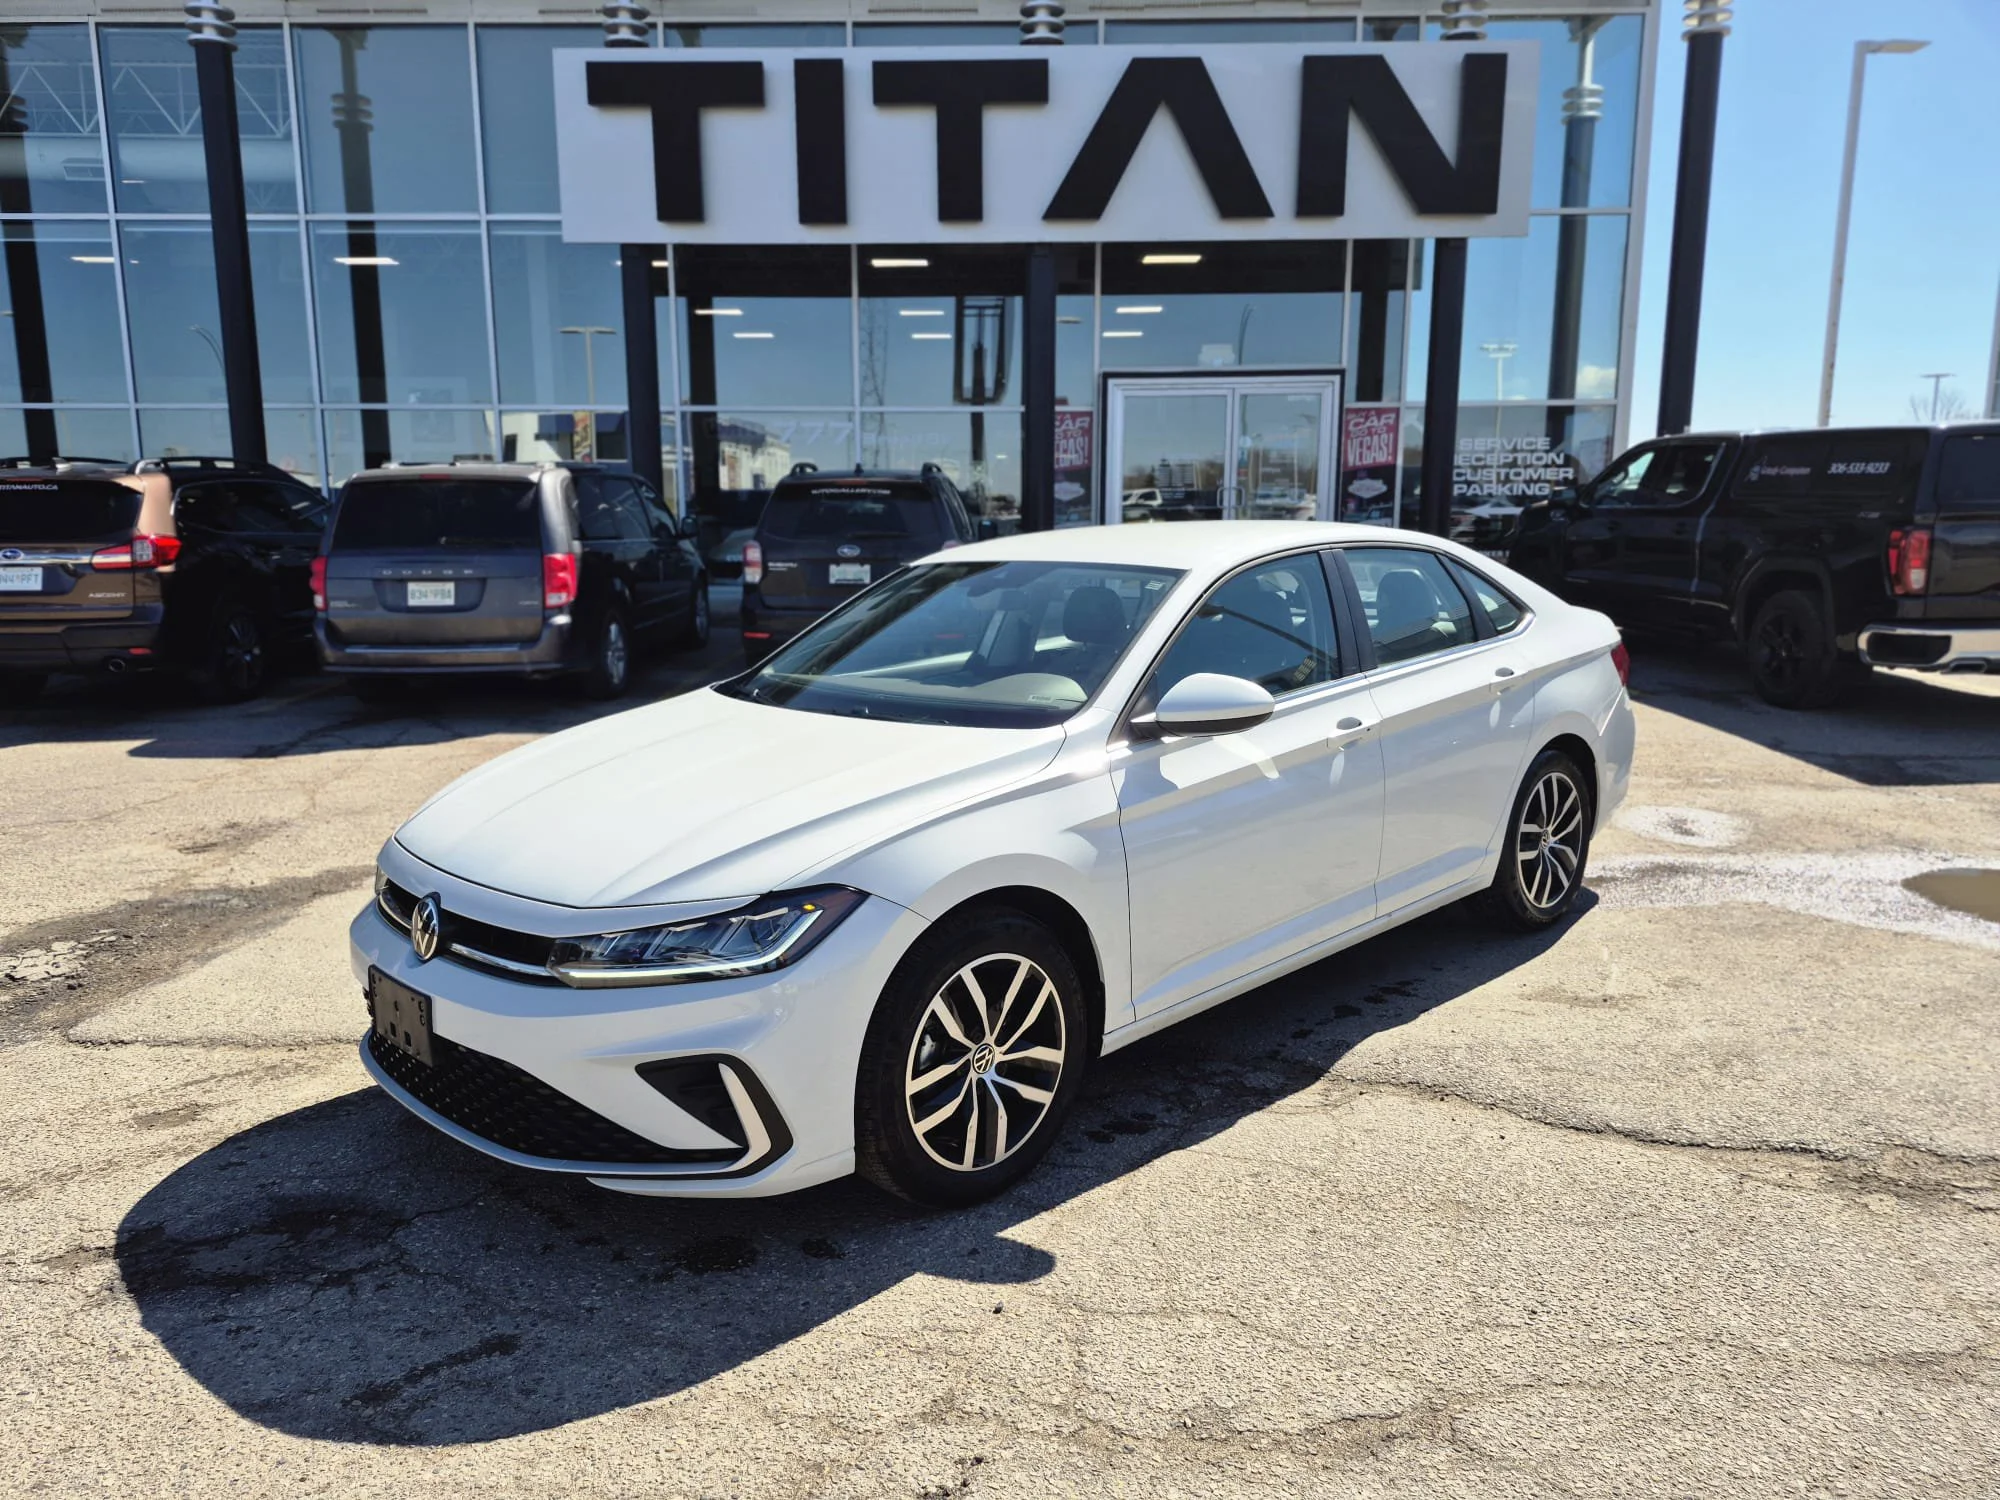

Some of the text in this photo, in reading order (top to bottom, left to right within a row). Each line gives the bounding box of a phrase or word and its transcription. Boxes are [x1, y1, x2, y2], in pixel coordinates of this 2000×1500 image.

[586, 53, 1507, 225] TITAN
[1349, 413, 1396, 430] CAR
[1347, 433, 1393, 467] VEGAS!
[1460, 437, 1551, 450] SERVICE
[1054, 436, 1088, 469] EGAS!
[1453, 467, 1574, 480] CUSTOMER
[1453, 483, 1550, 496] PARKING
